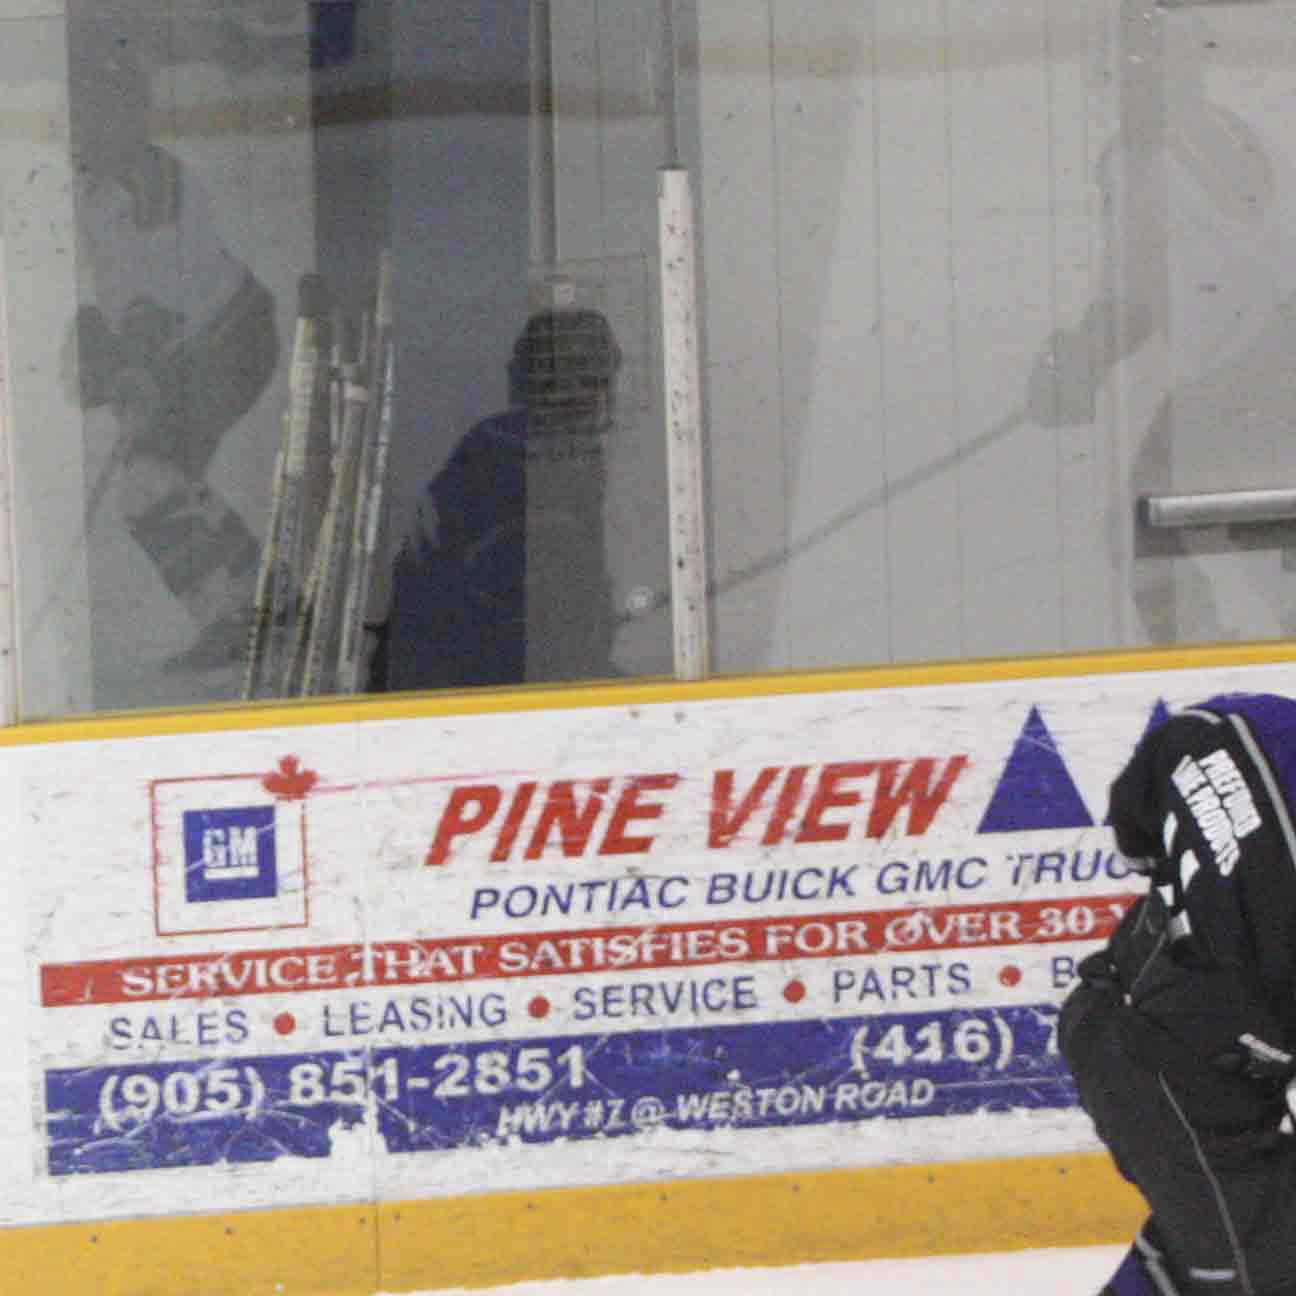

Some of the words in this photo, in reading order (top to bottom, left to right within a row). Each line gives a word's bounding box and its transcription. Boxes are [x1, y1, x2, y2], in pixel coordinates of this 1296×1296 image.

[424, 774, 680, 867] PINE
[708, 754, 969, 849] VIEW
[202, 825, 260, 867] GM
[469, 873, 691, 921] PONTIAC
[707, 864, 857, 905] BUICK
[875, 856, 989, 893] GMC
[1005, 847, 1130, 887] TRUC
[120, 949, 336, 997] SERVICE
[356, 942, 485, 987] THAT
[498, 929, 750, 972] SATISFIES
[766, 918, 869, 956] FOR
[885, 909, 1024, 949] OVER
[1037, 905, 1096, 937] 30
[110, 1009, 249, 1051] SALES
[322, 992, 509, 1038] LEASING
[572, 975, 757, 1022] SERVICE
[833, 962, 972, 1004] PARTS
[850, 1016, 1013, 1080] (416)
[98, 1061, 265, 1123] (905)
[675, 1085, 826, 1122] WESTON
[833, 1077, 936, 1111] ROAD
